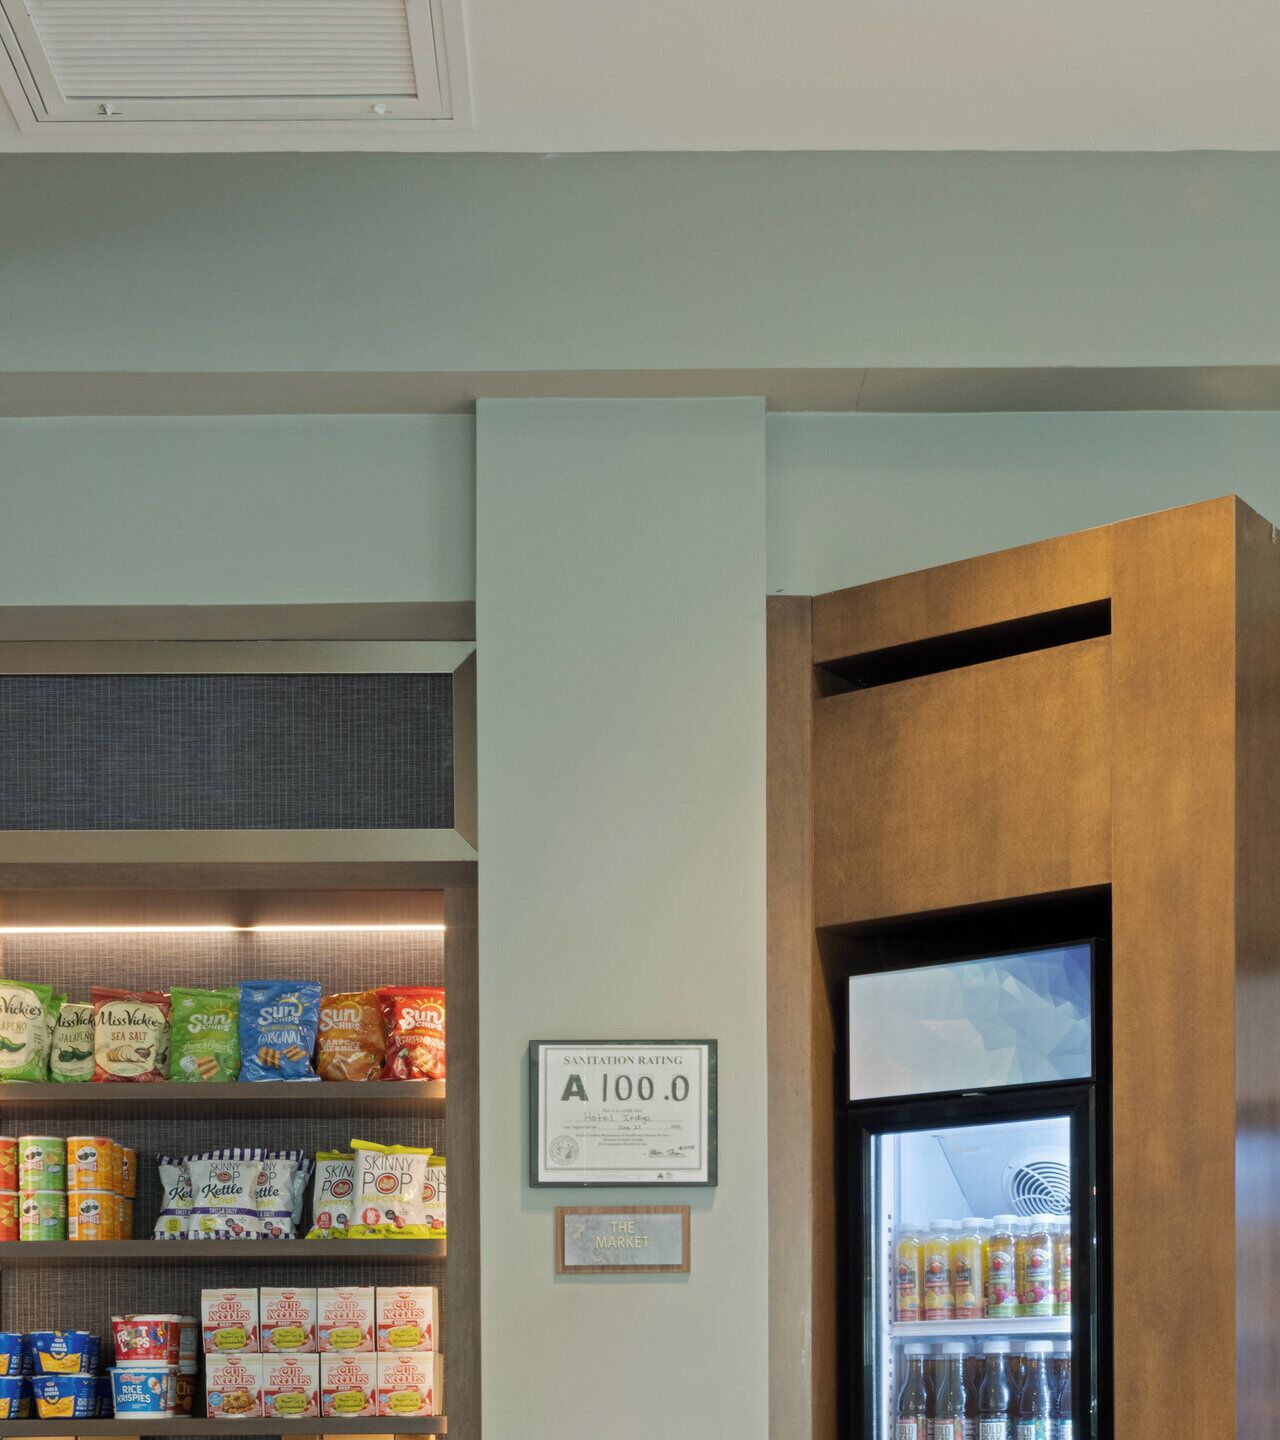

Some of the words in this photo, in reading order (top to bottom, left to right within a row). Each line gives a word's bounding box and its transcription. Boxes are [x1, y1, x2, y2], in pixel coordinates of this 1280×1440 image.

[258, 1005, 297, 1026] Sun
[320, 1008, 358, 1032] Sun
[399, 1008, 444, 1033] Sun
[188, 1013, 228, 1034] Sun
[111, 1032, 126, 1041] SEA
[129, 1032, 148, 1041] SALT
[563, 1055, 634, 1065] SANITATION
[638, 1055, 683, 1065] RATING
[560, 1073, 589, 1101] A
[210, 1162, 241, 1171] SKINNY
[363, 1155, 414, 1171] SKINNY
[202, 1184, 243, 1198] Kettle
[610, 1221, 635, 1234] THE
[596, 1236, 650, 1248] MARKET
[217, 1301, 241, 1312] CUP
[277, 1300, 301, 1311] CUP
[334, 1301, 358, 1311] CUP
[392, 1300, 416, 1310] CUP
[208, 1310, 250, 1321] NOODLES
[267, 1309, 309, 1320] NOODLES
[325, 1309, 366, 1320] NOODLES
[383, 1308, 425, 1319] NOODLES
[223, 1366, 246, 1375] CUP
[279, 1367, 303, 1376] CUP
[337, 1366, 361, 1375] CUP
[393, 1365, 417, 1375] CUP
[213, 1375, 255, 1386] NOODLES
[270, 1375, 312, 1386] NOODLES
[328, 1374, 369, 1385] NOODLES
[384, 1374, 425, 1385] NOODLES
[122, 1385, 143, 1394] RICE
[116, 1393, 151, 1404] KRISPIES
[981, 1425, 1002, 1435] GOLD
